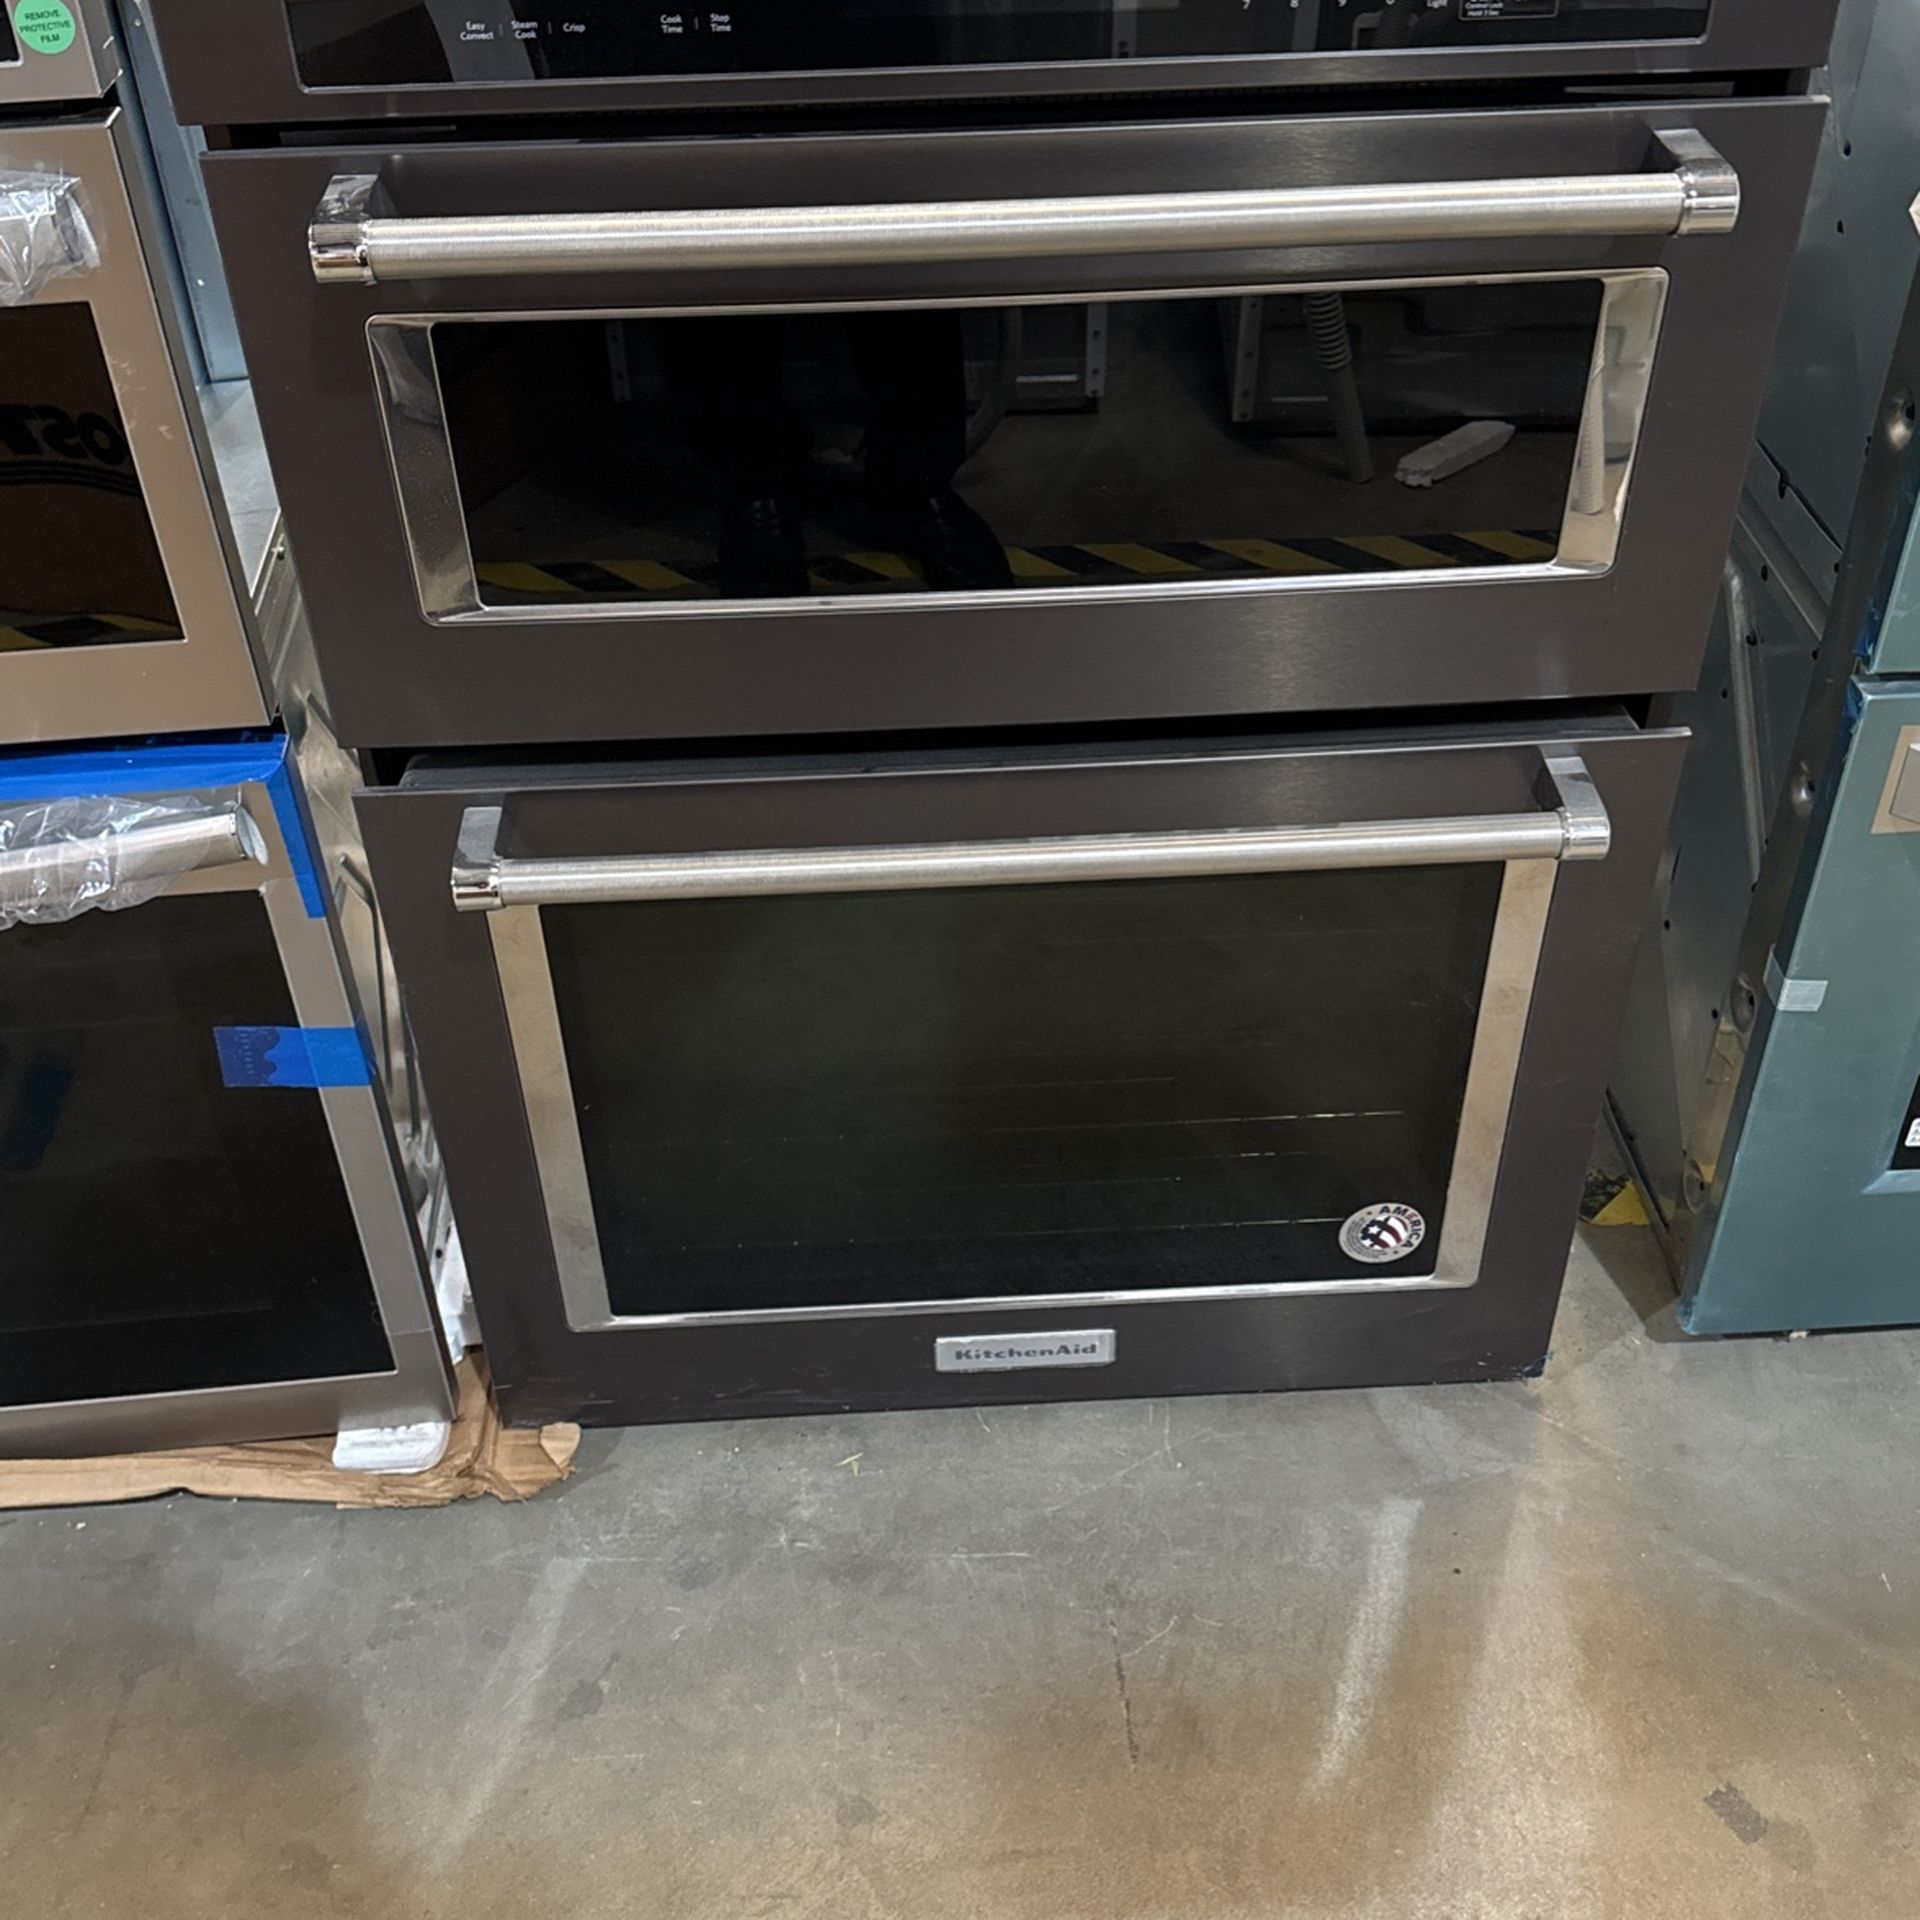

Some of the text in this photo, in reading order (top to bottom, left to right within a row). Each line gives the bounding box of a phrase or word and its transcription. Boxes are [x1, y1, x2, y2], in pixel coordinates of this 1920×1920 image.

[24, 9, 61, 20] REMOVE
[660, 14, 682, 24] Cook
[710, 13, 730, 23] Stop
[19, 20, 71, 33] PROTECTIVE
[466, 21, 485, 31] Easy
[511, 20, 538, 29] Steam
[563, 22, 586, 33] Crisp
[661, 24, 683, 33] Time
[710, 23, 732, 32] Time
[40, 34, 60, 43] FILM
[460, 31, 494, 40] Convect
[514, 30, 537, 39] Cook
[1379, 1205, 1421, 1248] AMERICA
[955, 1344, 1097, 1361] KitchenAid
